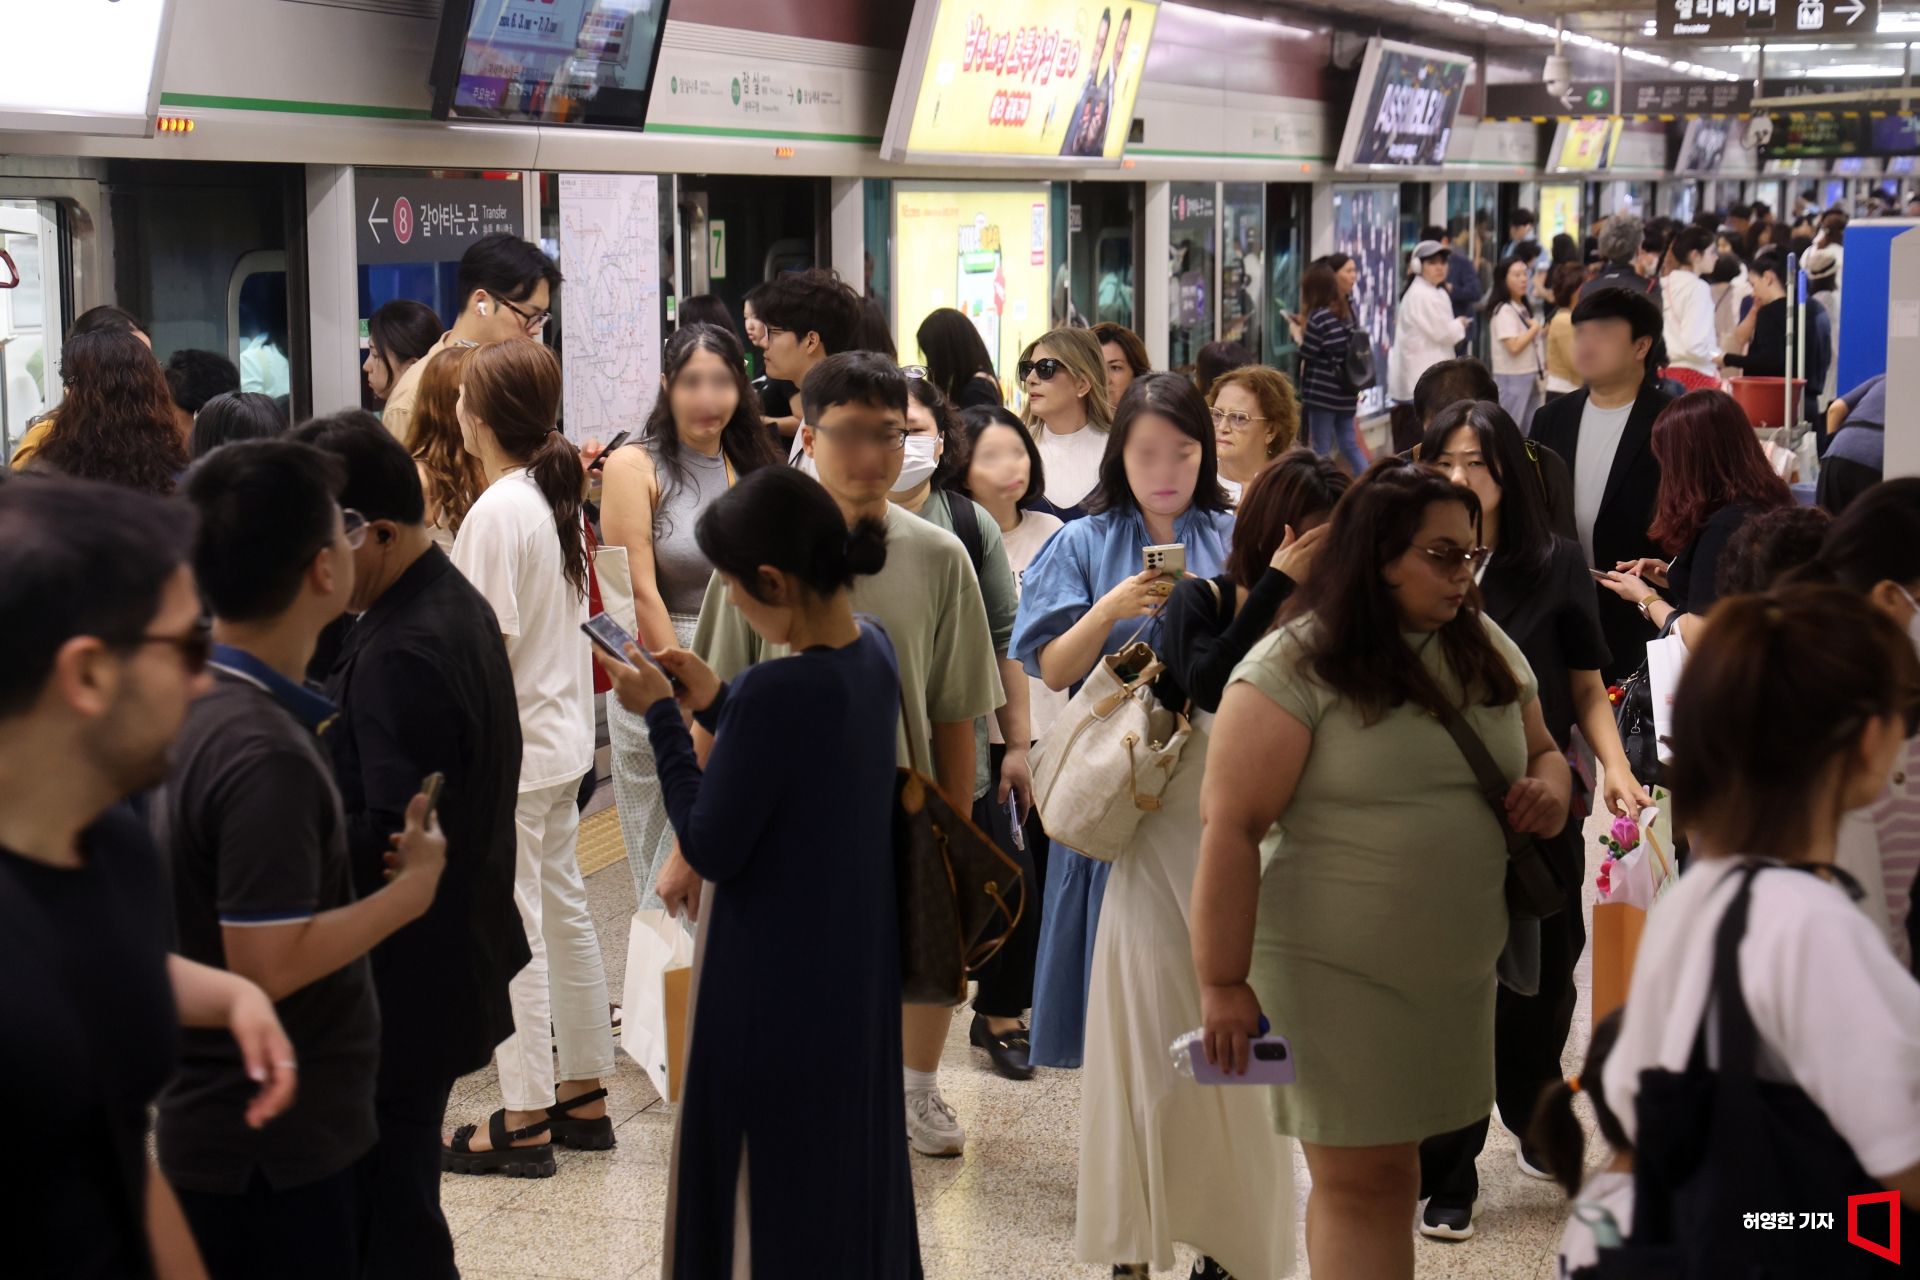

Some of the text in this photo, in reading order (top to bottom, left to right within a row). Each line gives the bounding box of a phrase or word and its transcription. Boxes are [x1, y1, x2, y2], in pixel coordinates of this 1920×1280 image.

[1592, 89, 1603, 106] 2
[399, 206, 408, 234] 8
[420, 203, 465, 237] 갈아타는
[467, 203, 479, 236] 곳
[482, 204, 507, 220] Transfer
[712, 229, 722, 269] 7
